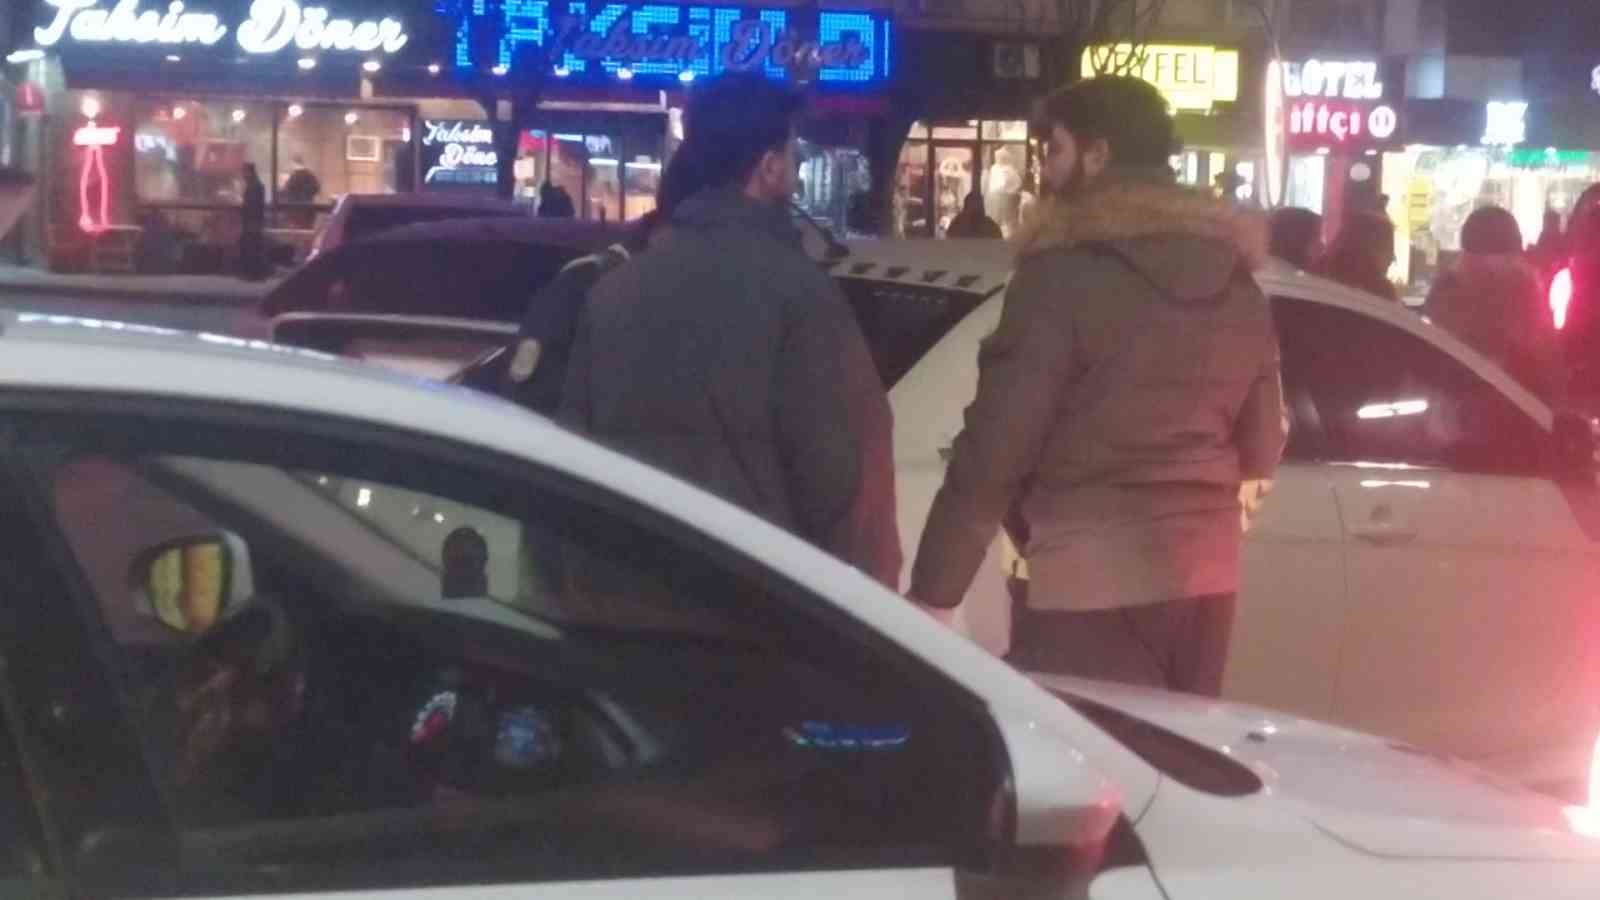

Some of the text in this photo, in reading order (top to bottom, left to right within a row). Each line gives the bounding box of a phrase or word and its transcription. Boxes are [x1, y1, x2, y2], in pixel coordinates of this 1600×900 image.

[34, 0, 408, 52] Taksim Döner
[439, 143, 498, 167] Döne
